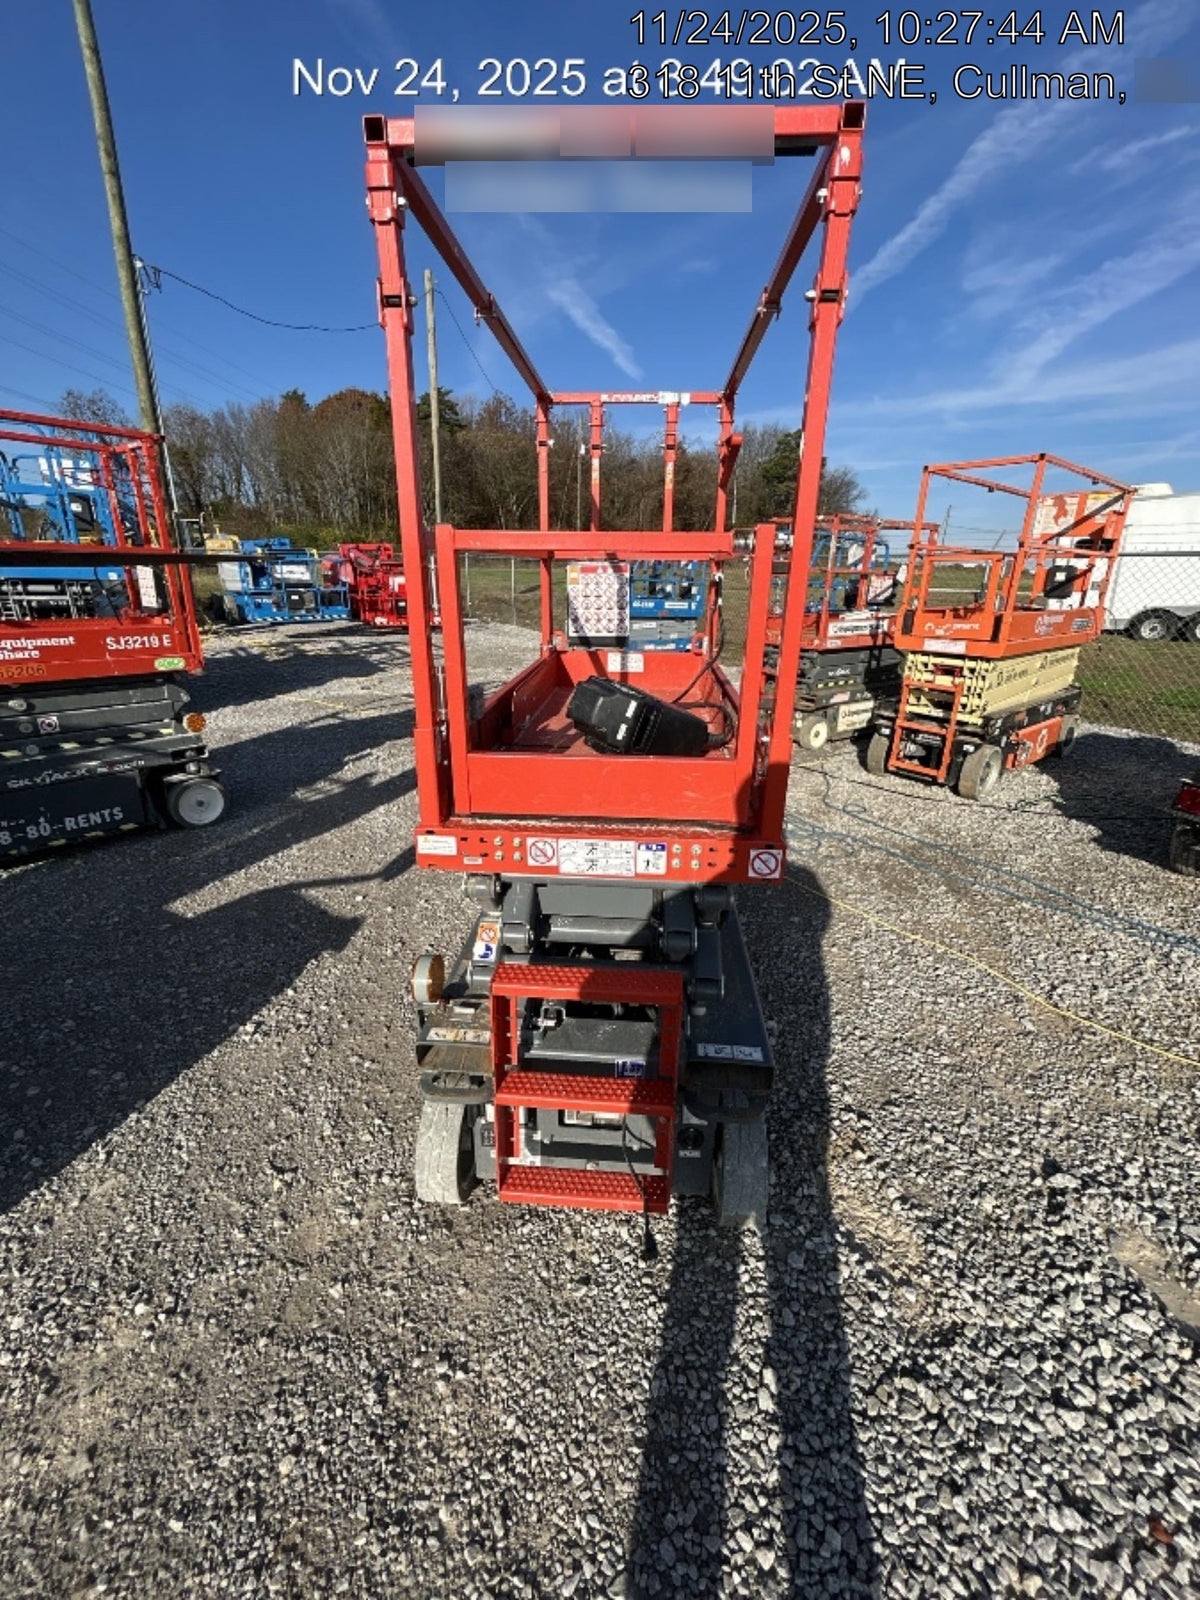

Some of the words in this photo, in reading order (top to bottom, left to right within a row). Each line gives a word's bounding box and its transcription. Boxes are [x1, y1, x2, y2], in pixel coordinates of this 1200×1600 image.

[0, 636, 75, 650] quipment
[106, 635, 160, 650] SJ3219
[162, 634, 172, 647] E
